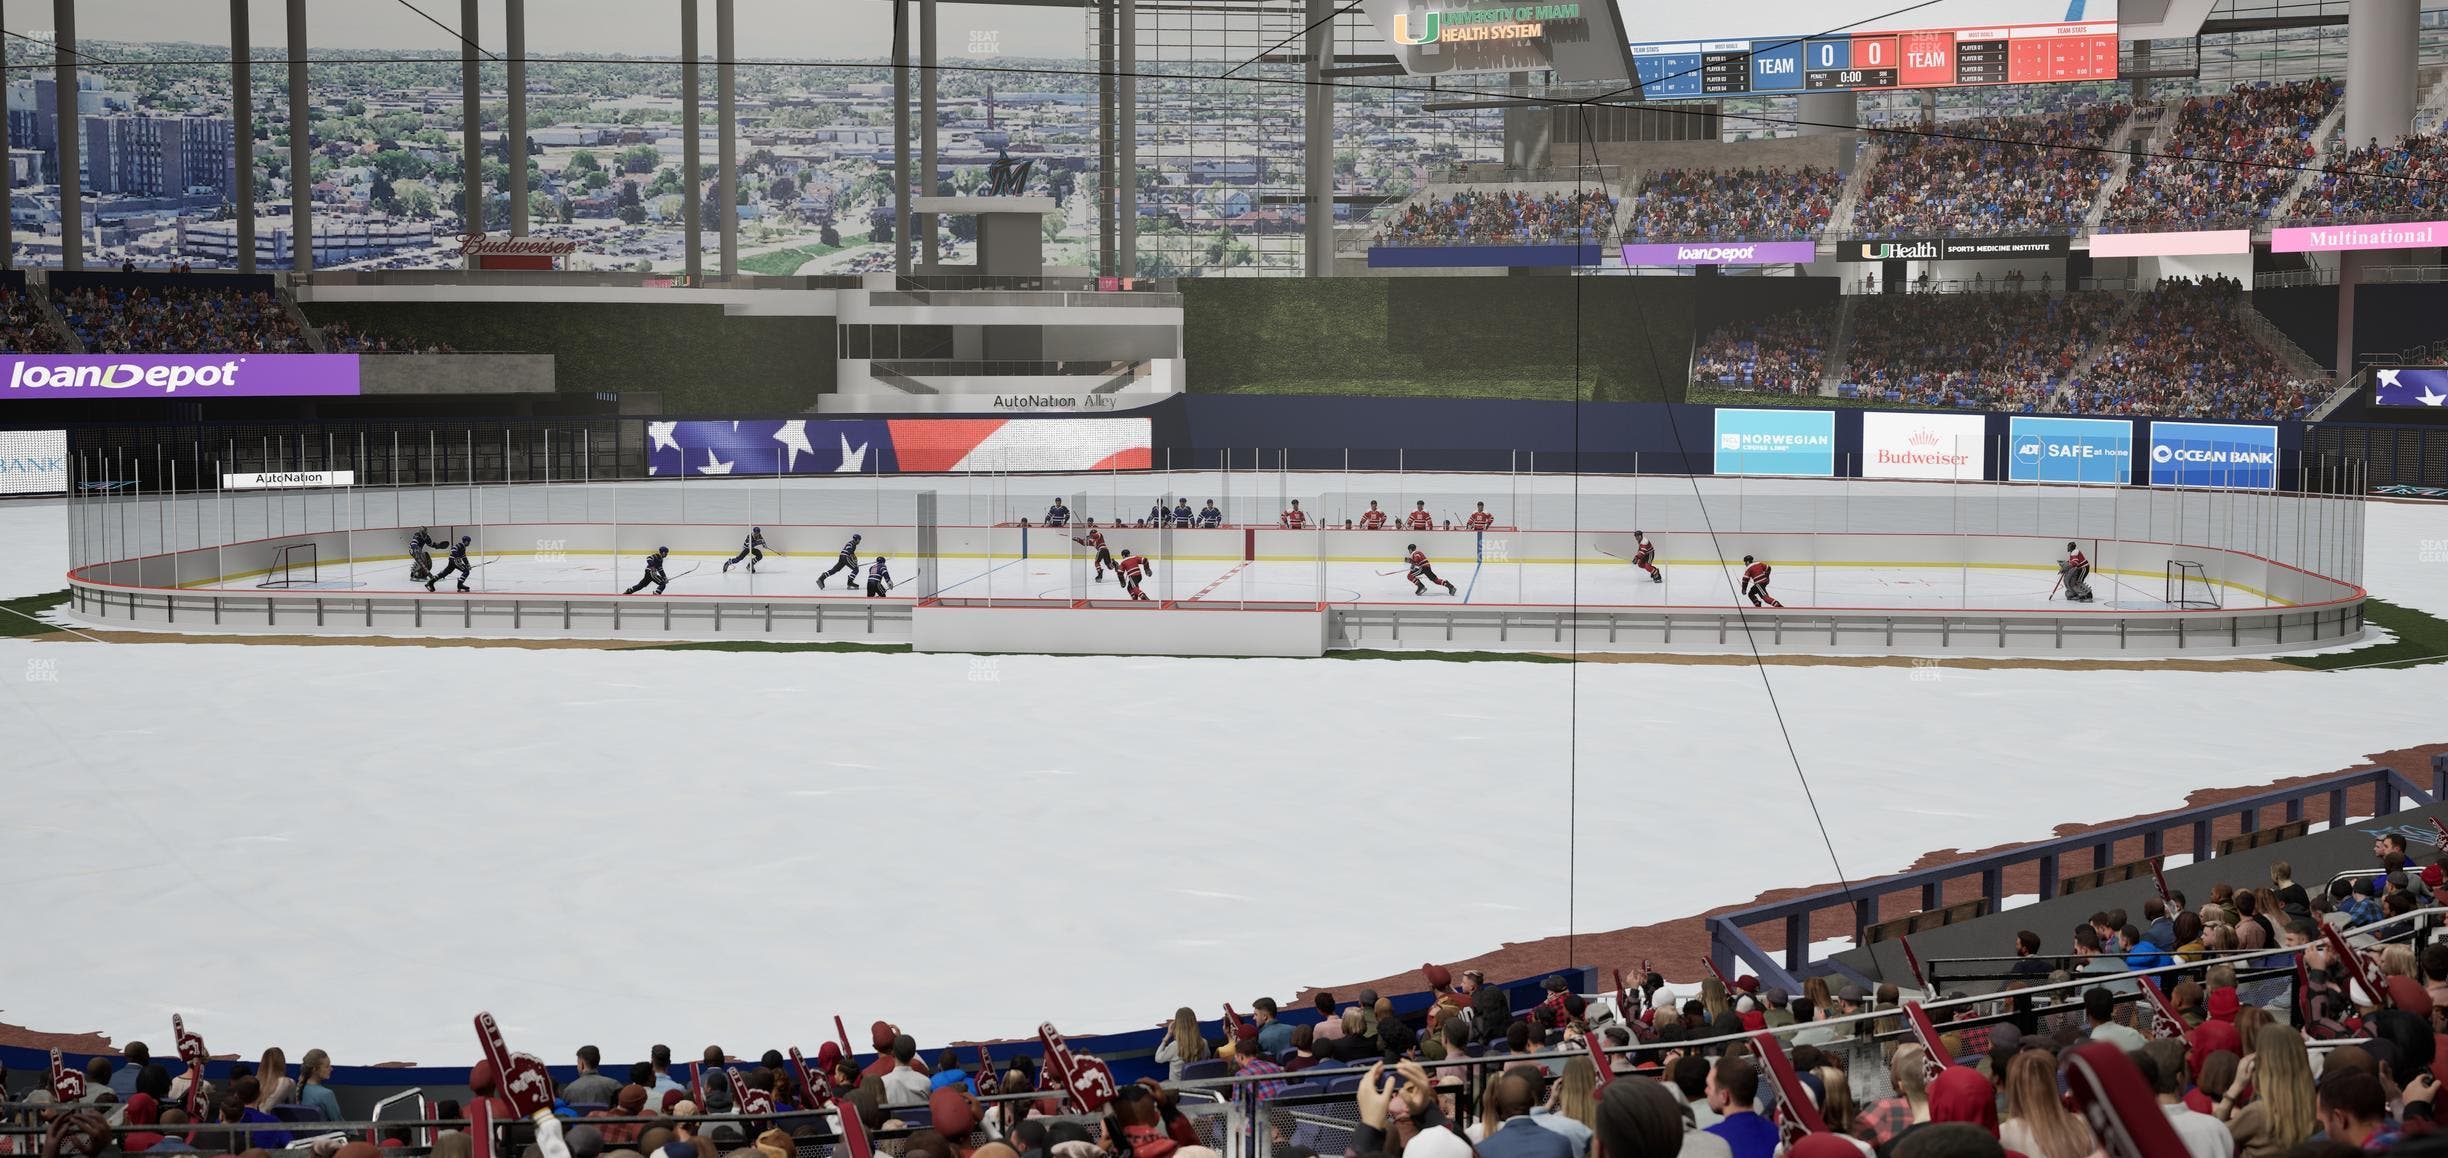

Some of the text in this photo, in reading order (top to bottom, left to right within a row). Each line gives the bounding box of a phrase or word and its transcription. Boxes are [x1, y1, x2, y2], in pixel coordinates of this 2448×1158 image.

[1441, 4, 1579, 25] UNIVERSITY OF MIAMI
[1441, 23, 1542, 42] HEALTH SYSTEM
[1821, 44, 1834, 67] 0
[1868, 42, 1881, 65] 0
[1907, 52, 1946, 68] TEAM
[1758, 58, 1794, 74] TEAM
[1840, 71, 1862, 83] 0:00
[455, 232, 576, 256] Budweiser
[2310, 227, 2433, 246] Multinational
[1677, 246, 1755, 262] loanDepot
[1947, 243, 2050, 253] SPORTS MEDICINE INSTITUTE
[10, 360, 240, 393] loanDepot
[993, 394, 1117, 410] AutoNation Alley
[1742, 434, 1829, 445] NORWEGIAN
[2018, 443, 2040, 455] ADT
[2048, 443, 2129, 458] SAFE at home
[2174, 449, 2274, 464] OCEAN BANK
[1878, 449, 1968, 466] Budweiser
[255, 472, 323, 484] AutoNation
